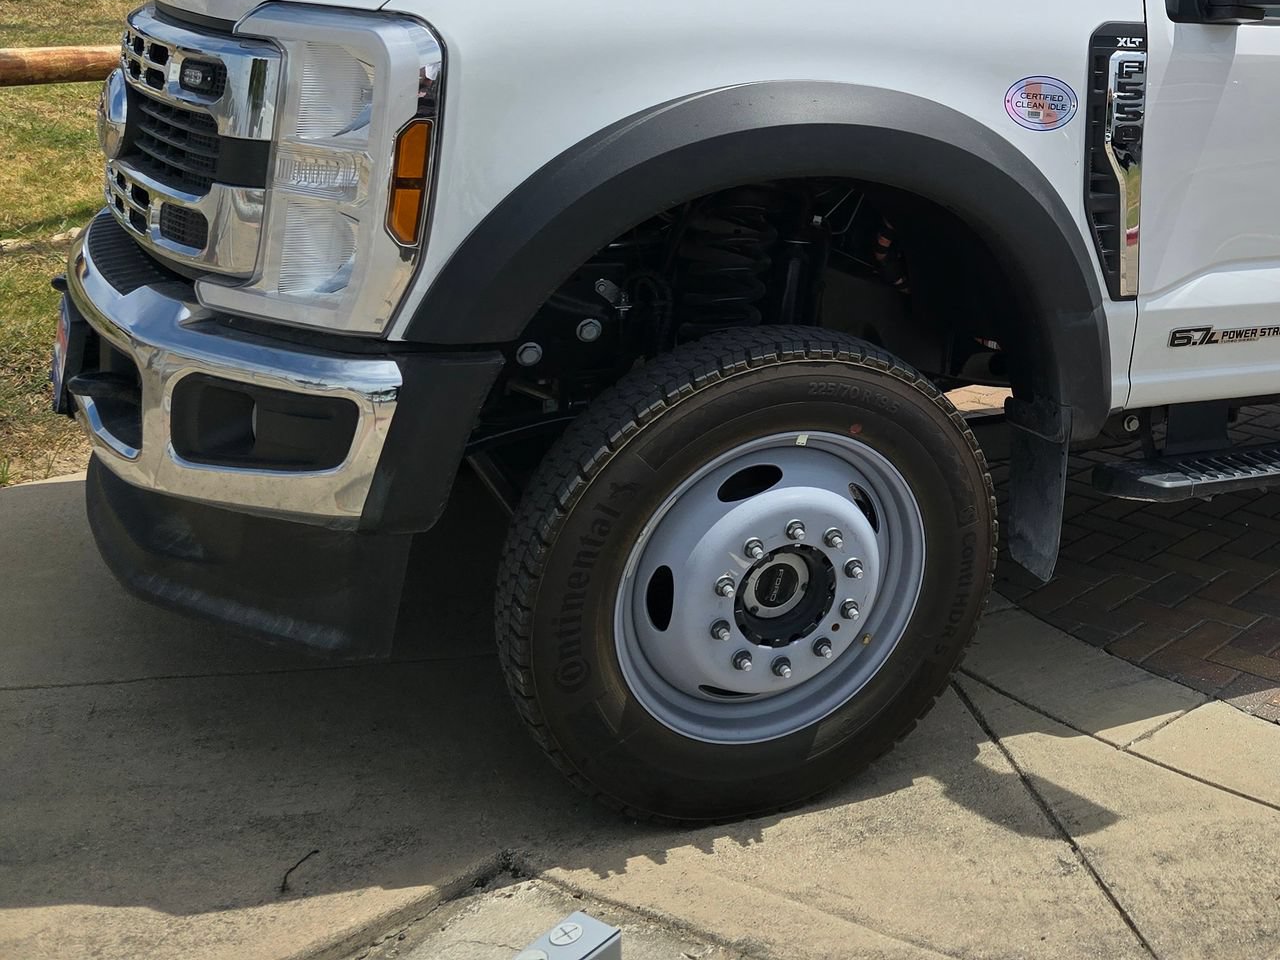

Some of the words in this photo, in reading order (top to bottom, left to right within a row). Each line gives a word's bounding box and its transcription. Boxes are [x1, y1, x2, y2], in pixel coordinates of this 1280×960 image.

[1116, 38, 1142, 47] XLT
[1016, 101, 1044, 110] CLEAN
[1048, 103, 1067, 111] IDLE
[1020, 92, 1064, 102] CERTIFIED
[1170, 327, 1219, 348] 6.7L
[1221, 328, 1258, 340] POWER
[808, 382, 860, 401] 225/70
[770, 568, 784, 602] FORD
[553, 502, 623, 693] Continental
